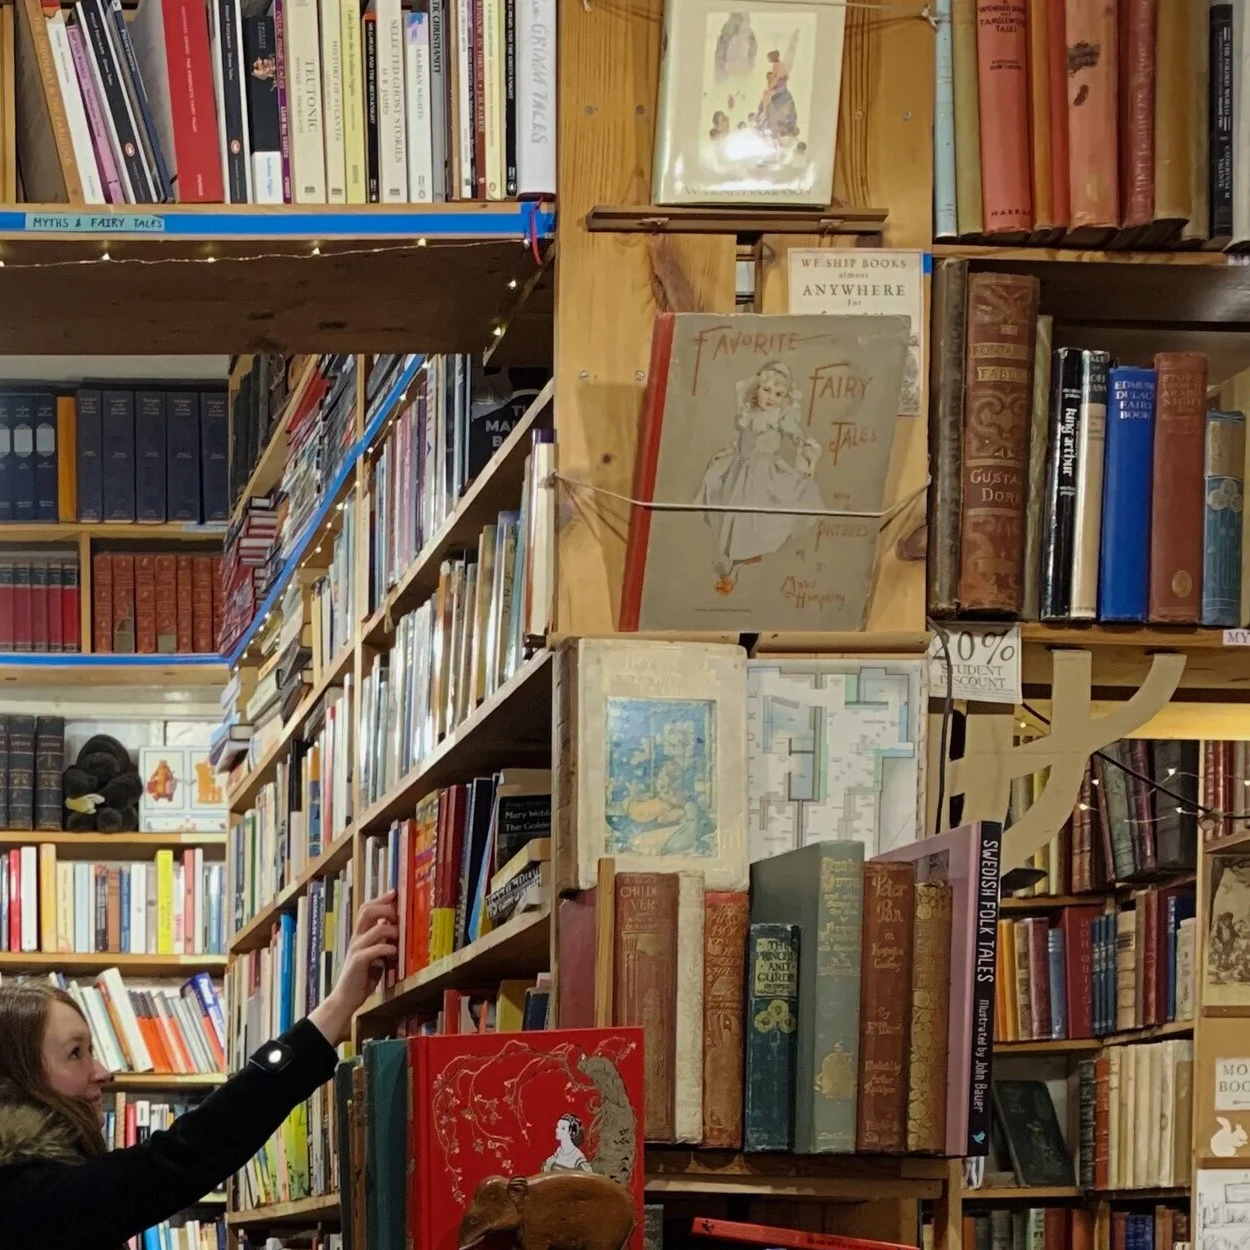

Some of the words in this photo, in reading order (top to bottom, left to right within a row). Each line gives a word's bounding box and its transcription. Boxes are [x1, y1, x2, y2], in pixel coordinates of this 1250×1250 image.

[332, 41, 341, 77] HISTORY
[390, 19, 402, 75] SELECTED
[432, 15, 443, 75] CHRISTIANITY
[529, 23, 549, 86] GRIMM
[415, 48, 424, 83] ARABIAN
[306, 60, 318, 133] TEUTONIC
[333, 82, 341, 94] OF
[383, 88, 392, 115] JAMES
[392, 77, 403, 113] GHOST
[417, 86, 425, 120] NIGHTS
[333, 95, 342, 142] ATLANTIS
[530, 90, 550, 145] TALES
[393, 117, 405, 163] STORIES
[32, 217, 69, 228] MYTHS
[76, 218, 81, 227] &
[91, 217, 125, 228] FAIRY
[133, 218, 163, 229] TALES
[826, 258, 856, 269] SHIP
[861, 259, 907, 269] BOOKS
[838, 270, 869, 279] almost
[802, 284, 906, 297] ANYWHERE
[692, 325, 800, 398] FAVORITE
[807, 363, 874, 428] FAIRY
[1060, 407, 1078, 436] king
[1120, 411, 1150, 420] BOOK
[828, 421, 877, 467] TALES
[1062, 437, 1075, 478] arthur
[933, 630, 1015, 665] 20%
[505, 811, 527, 820] Mary
[505, 823, 522, 831] The
[981, 839, 999, 897] SWEDISH
[979, 900, 995, 936] FOLK
[977, 939, 994, 984] TALES
[977, 999, 990, 1045] Illustrated
[975, 1059, 988, 1081] John
[976, 1046, 988, 1058] by
[973, 1083, 987, 1114] Bauer
